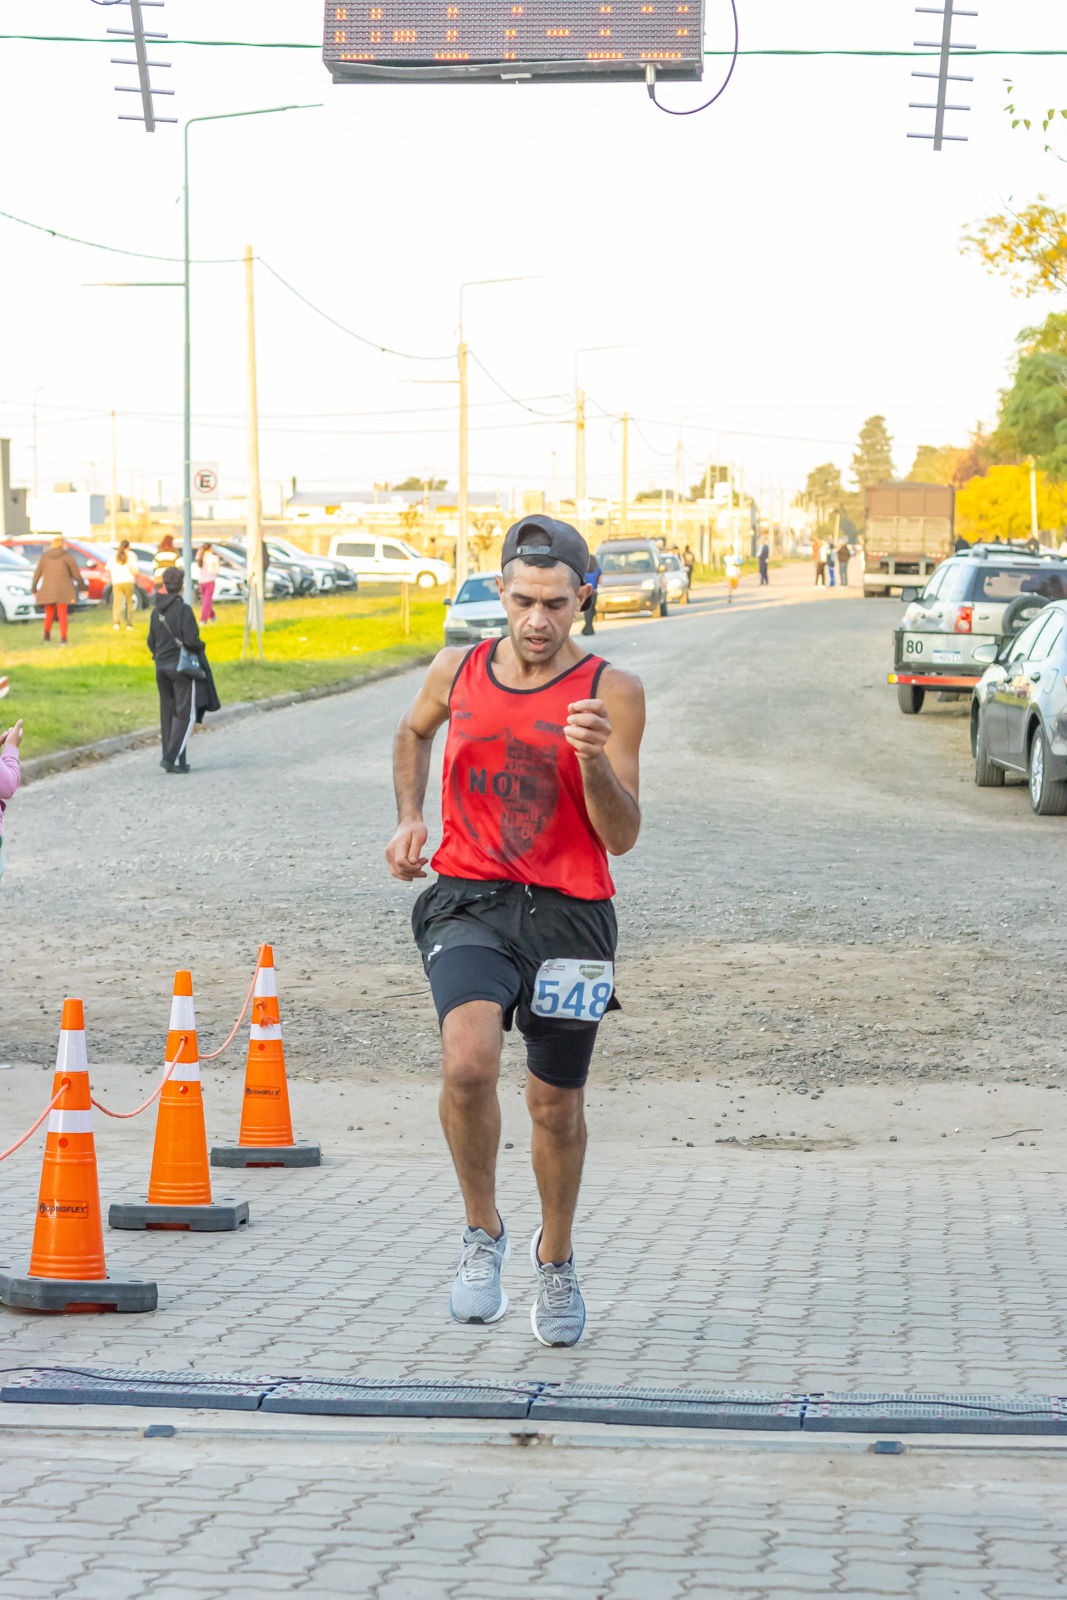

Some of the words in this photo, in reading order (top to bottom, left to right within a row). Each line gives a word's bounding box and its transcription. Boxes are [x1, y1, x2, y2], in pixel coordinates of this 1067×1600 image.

[199, 474, 212, 489] E
[906, 640, 924, 654] 80
[535, 980, 611, 1018] 548
